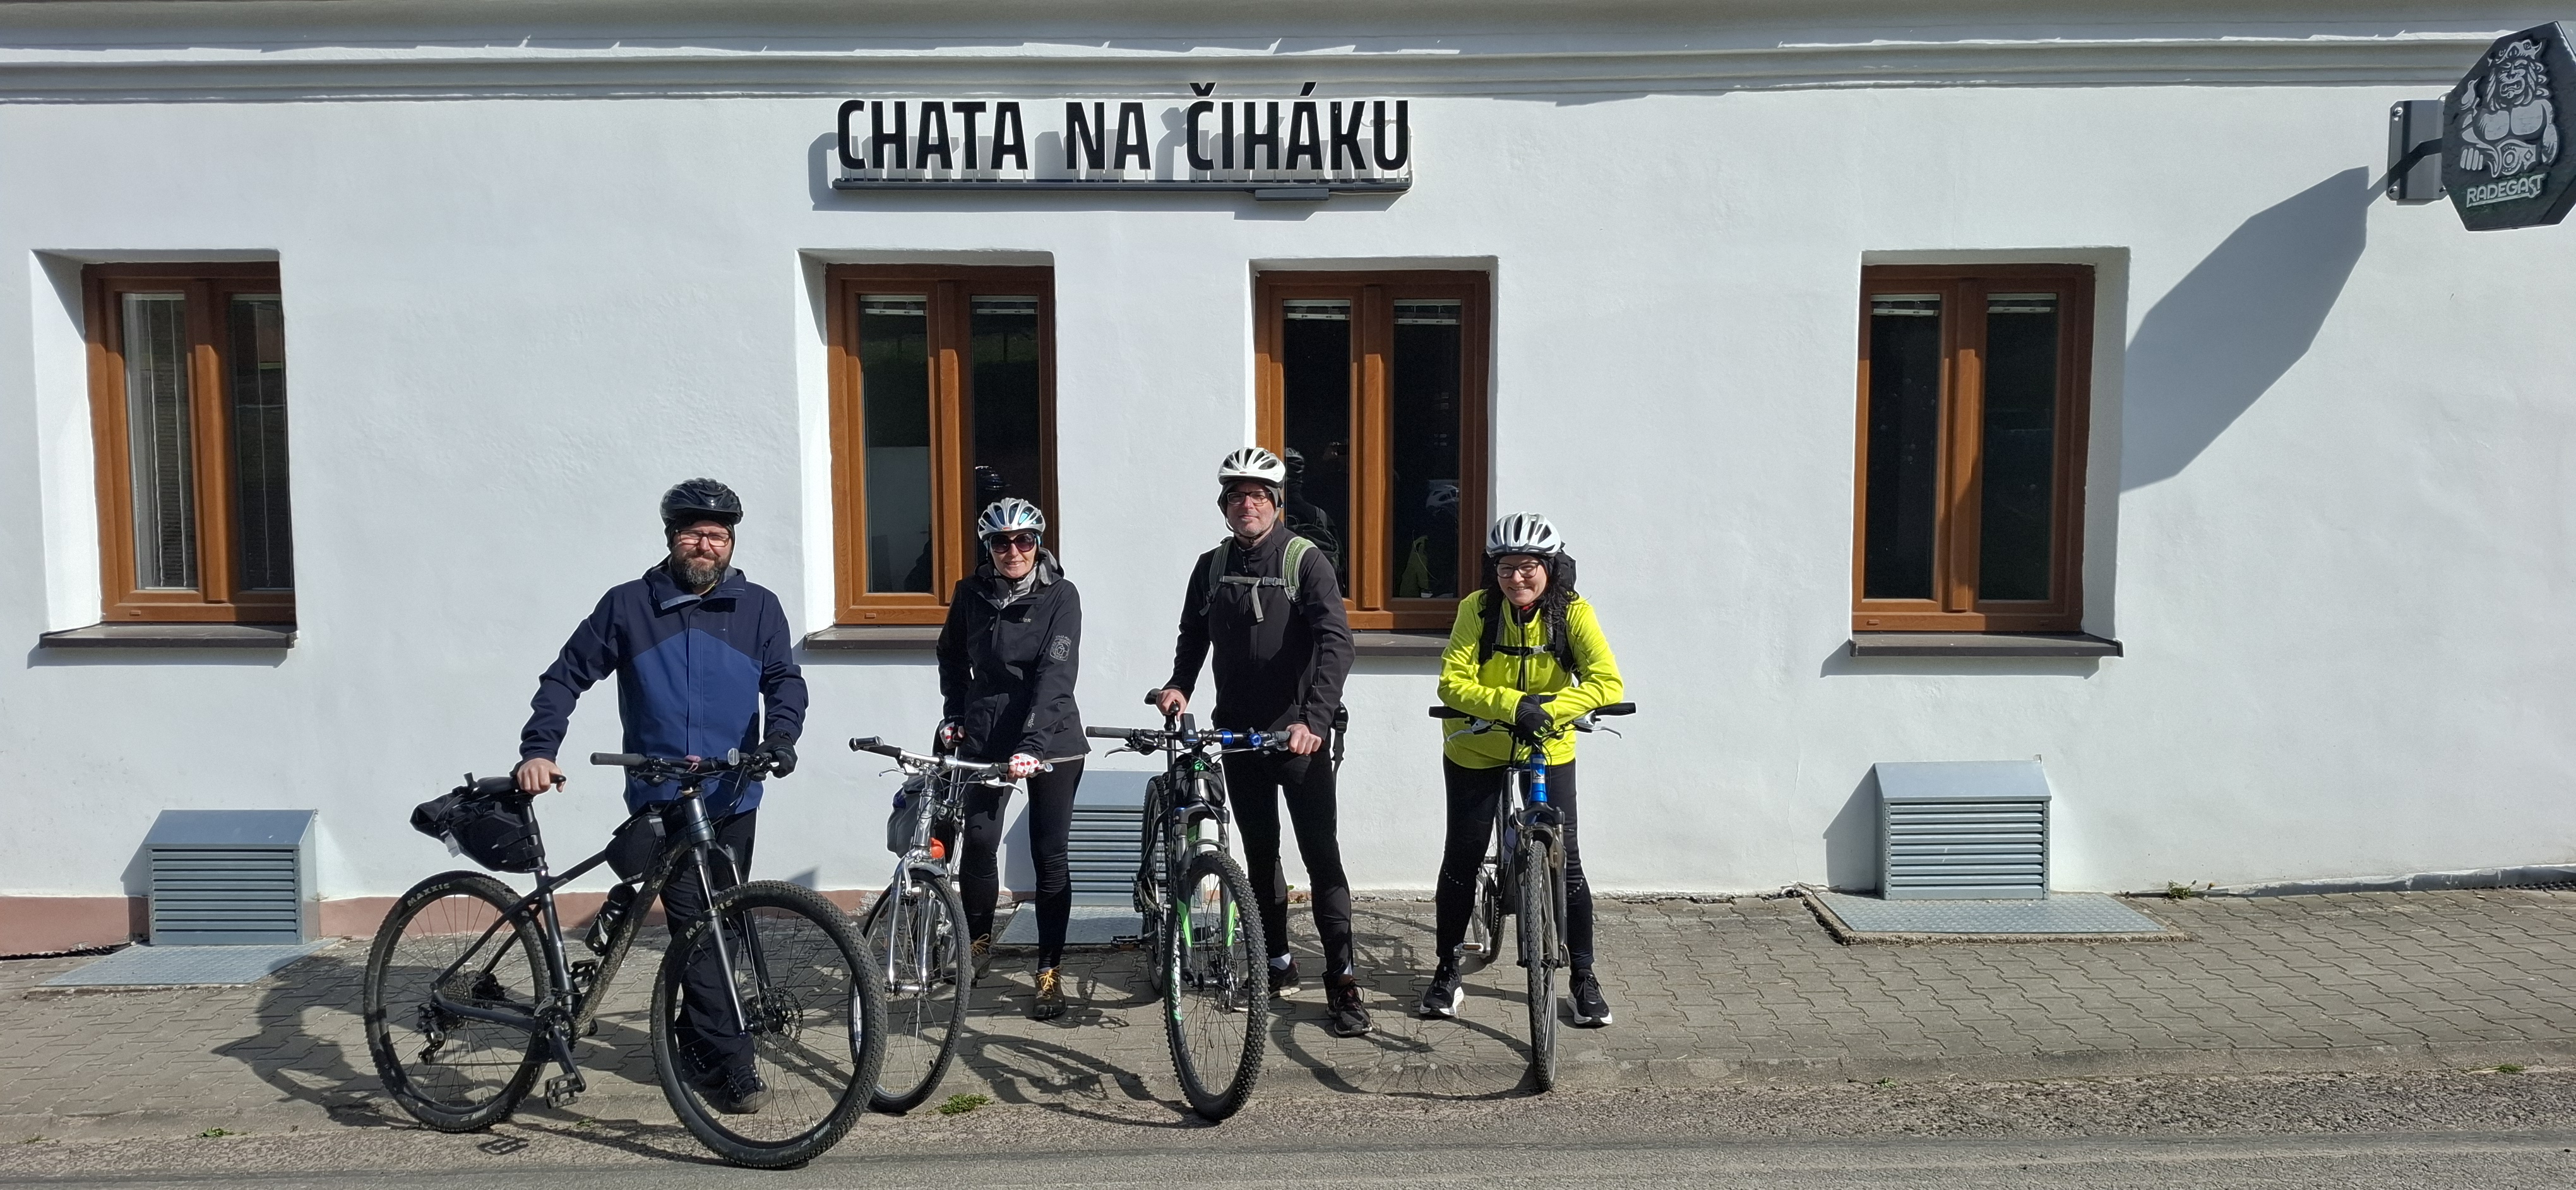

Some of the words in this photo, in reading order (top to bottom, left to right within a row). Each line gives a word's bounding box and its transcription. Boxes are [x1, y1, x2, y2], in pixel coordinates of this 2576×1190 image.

[837, 99, 1029, 170] CHATA
[1066, 102, 1151, 171] NA
[1186, 81, 1409, 171] ČIHÁKU
[2466, 173, 2545, 207] RADEGAST
[407, 883, 450, 907] MAXXIS
[686, 899, 732, 939] MAIS
